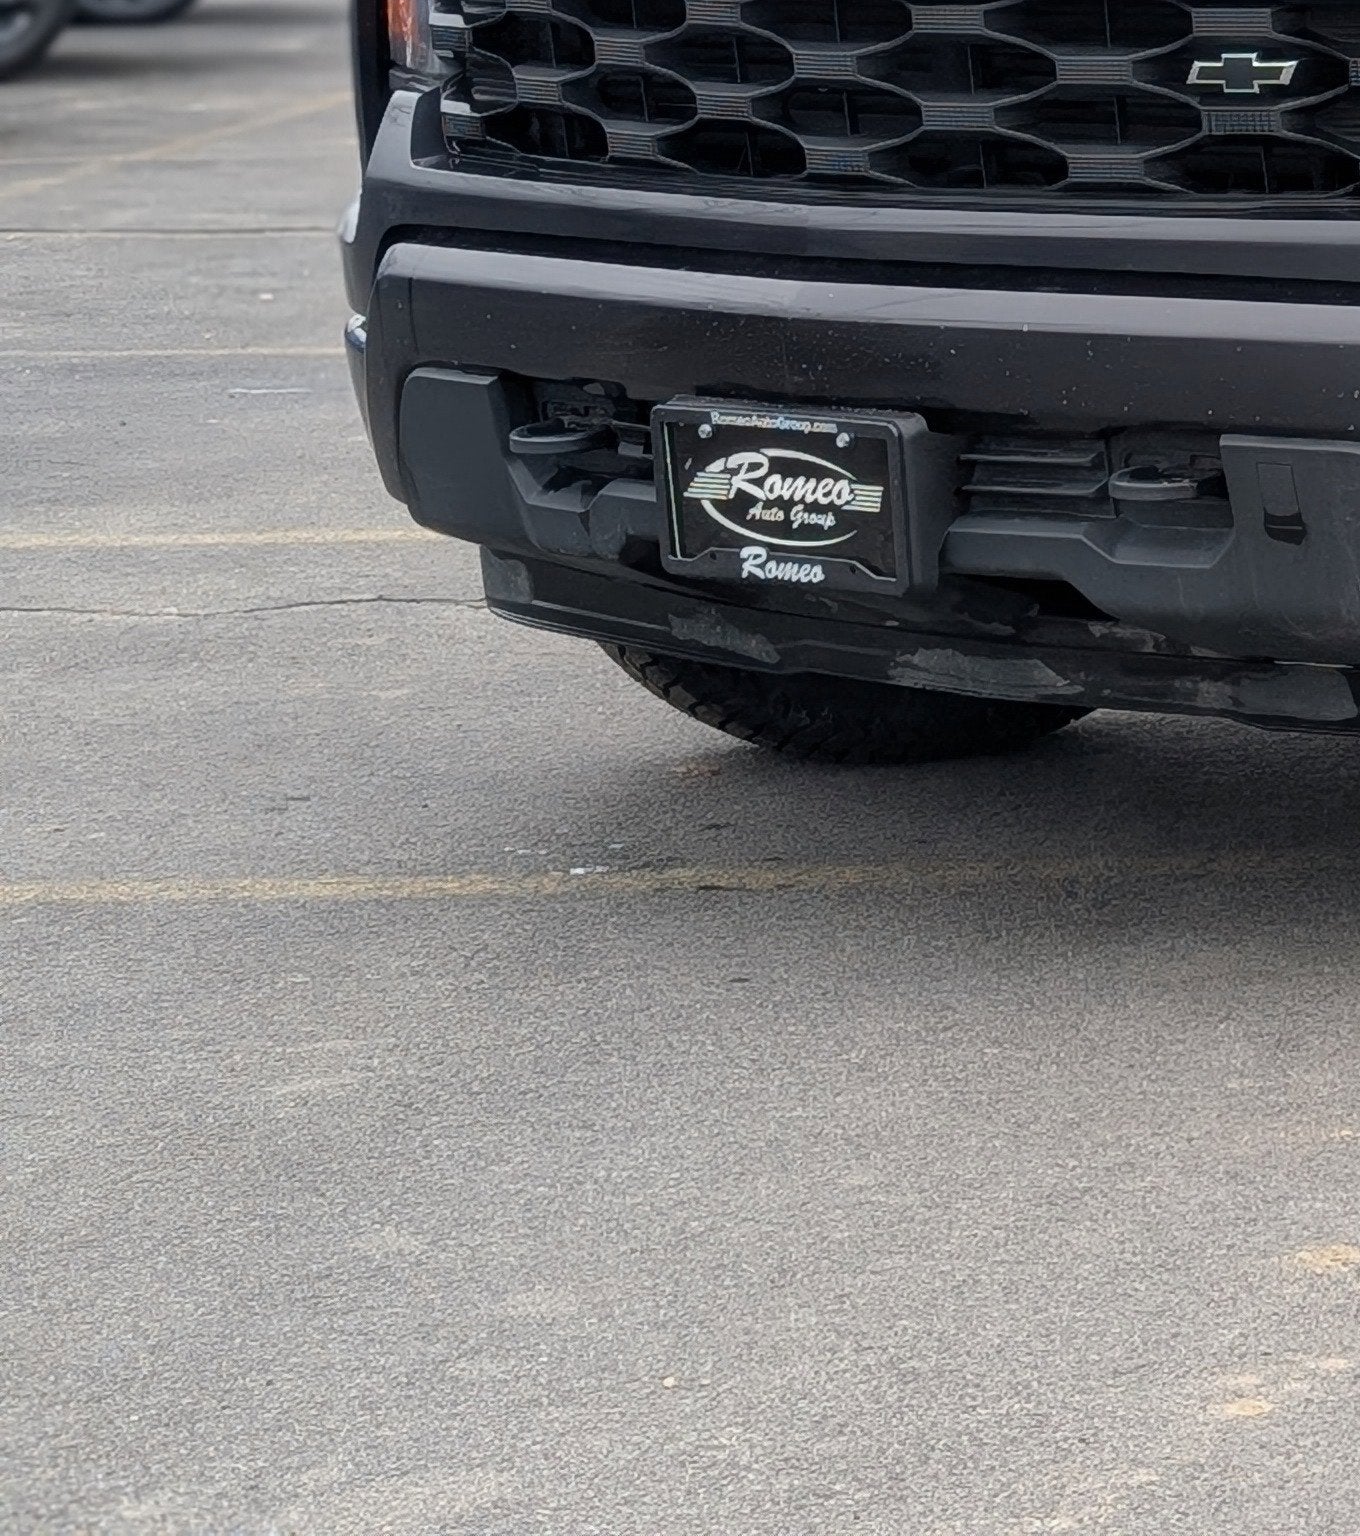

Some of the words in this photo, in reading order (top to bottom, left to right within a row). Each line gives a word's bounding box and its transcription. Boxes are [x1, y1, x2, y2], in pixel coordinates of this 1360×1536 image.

[725, 451, 854, 506] Romeo
[745, 501, 784, 522] Auto
[789, 503, 836, 530] Group
[739, 545, 825, 584] Romeo
